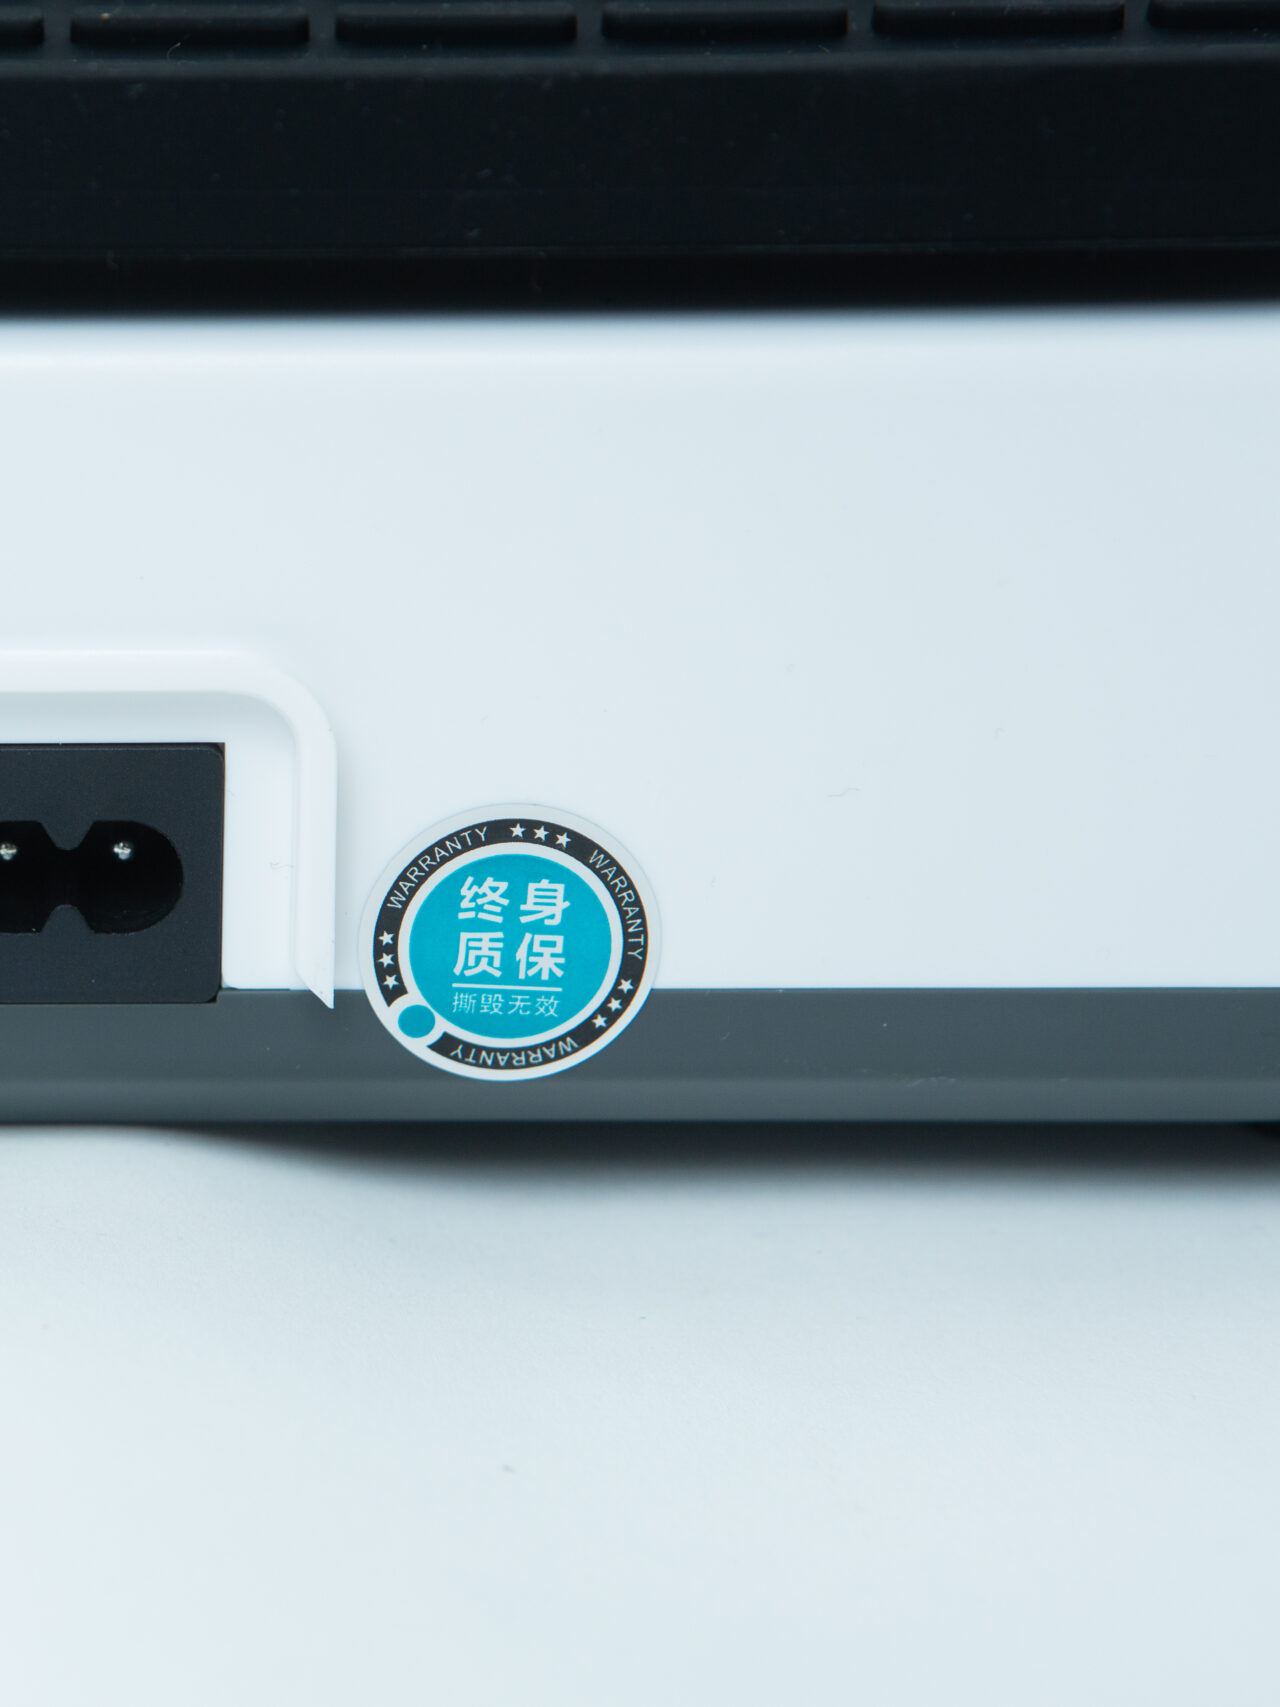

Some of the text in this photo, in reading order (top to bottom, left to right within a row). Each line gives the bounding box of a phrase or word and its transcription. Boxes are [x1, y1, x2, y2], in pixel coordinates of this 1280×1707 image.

[387, 826, 488, 910] WARRANTY
[457, 876, 571, 926] 终身
[589, 849, 643, 960] WARRANTY
[453, 931, 567, 981] 质保
[452, 992, 561, 1017] 撕毁无效
[450, 1036, 579, 1067] WARRANTY
